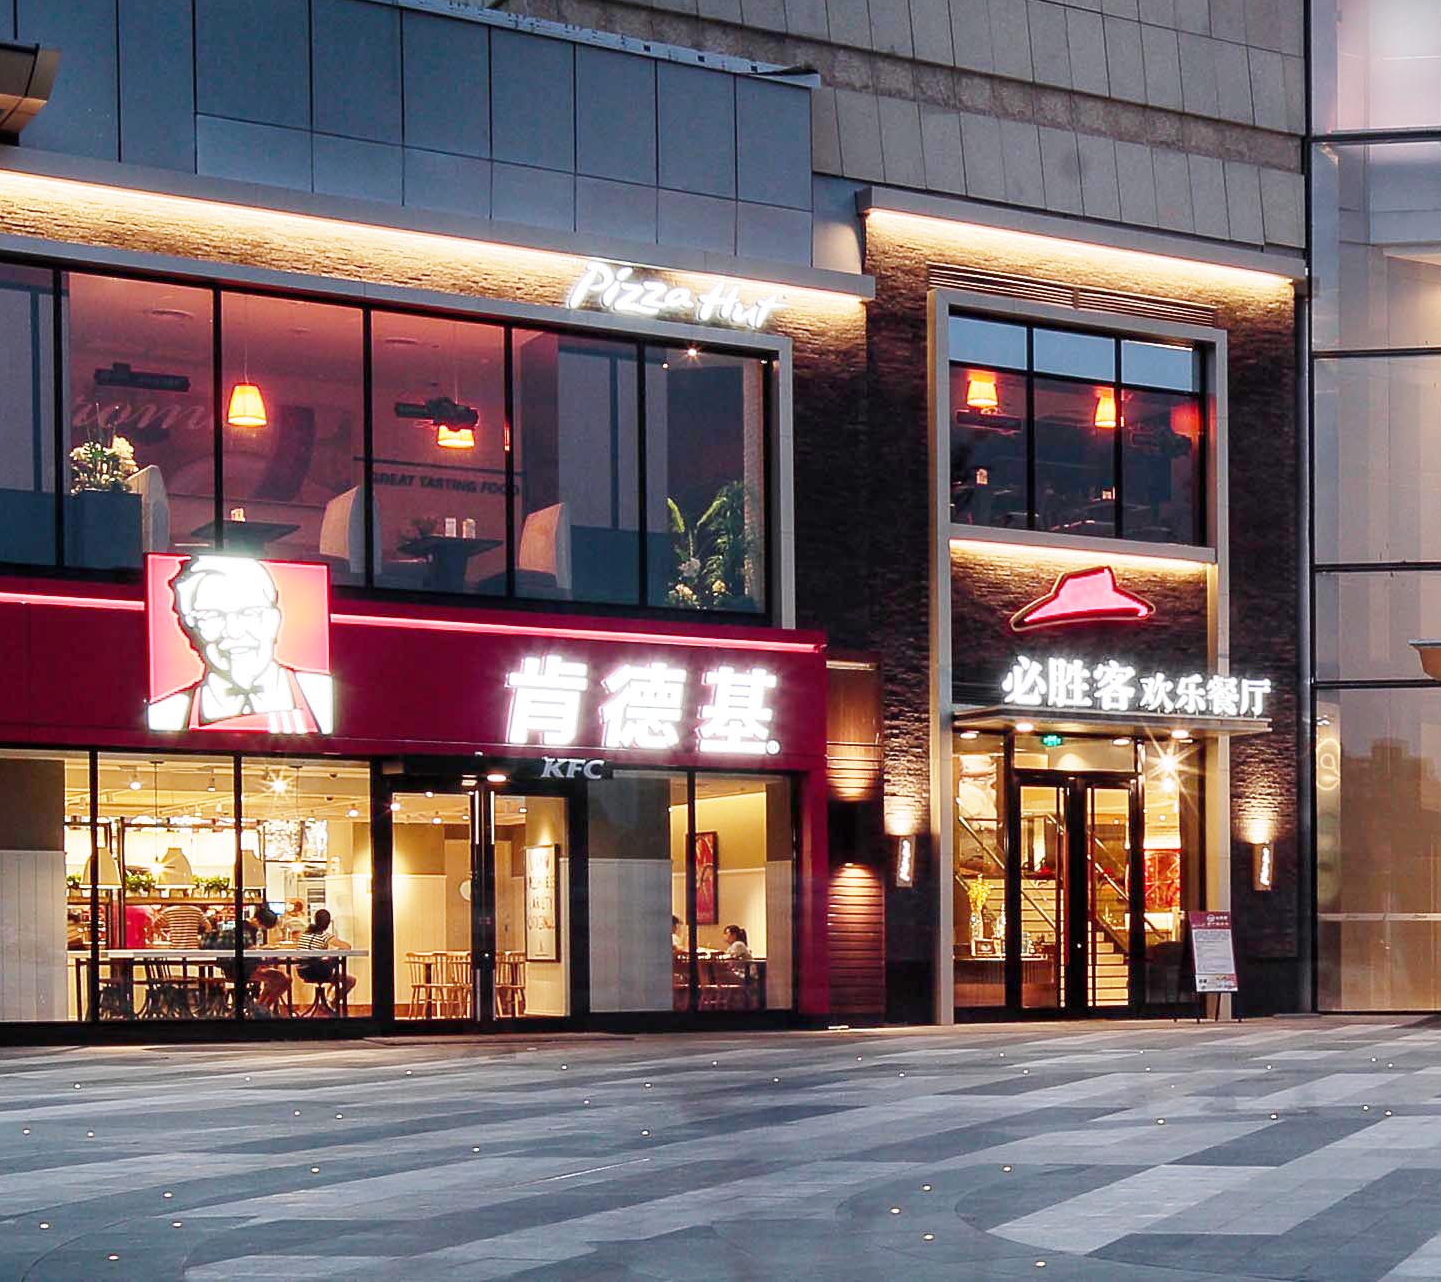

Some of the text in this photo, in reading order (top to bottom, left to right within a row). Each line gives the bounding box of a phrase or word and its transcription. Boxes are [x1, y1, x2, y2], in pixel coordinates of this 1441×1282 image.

[566, 260, 788, 330] Pizza Hut
[505, 653, 778, 754] 肯德基
[1001, 655, 1272, 717] 必胜客 欢乐餐厅
[541, 756, 605, 780] KFC
